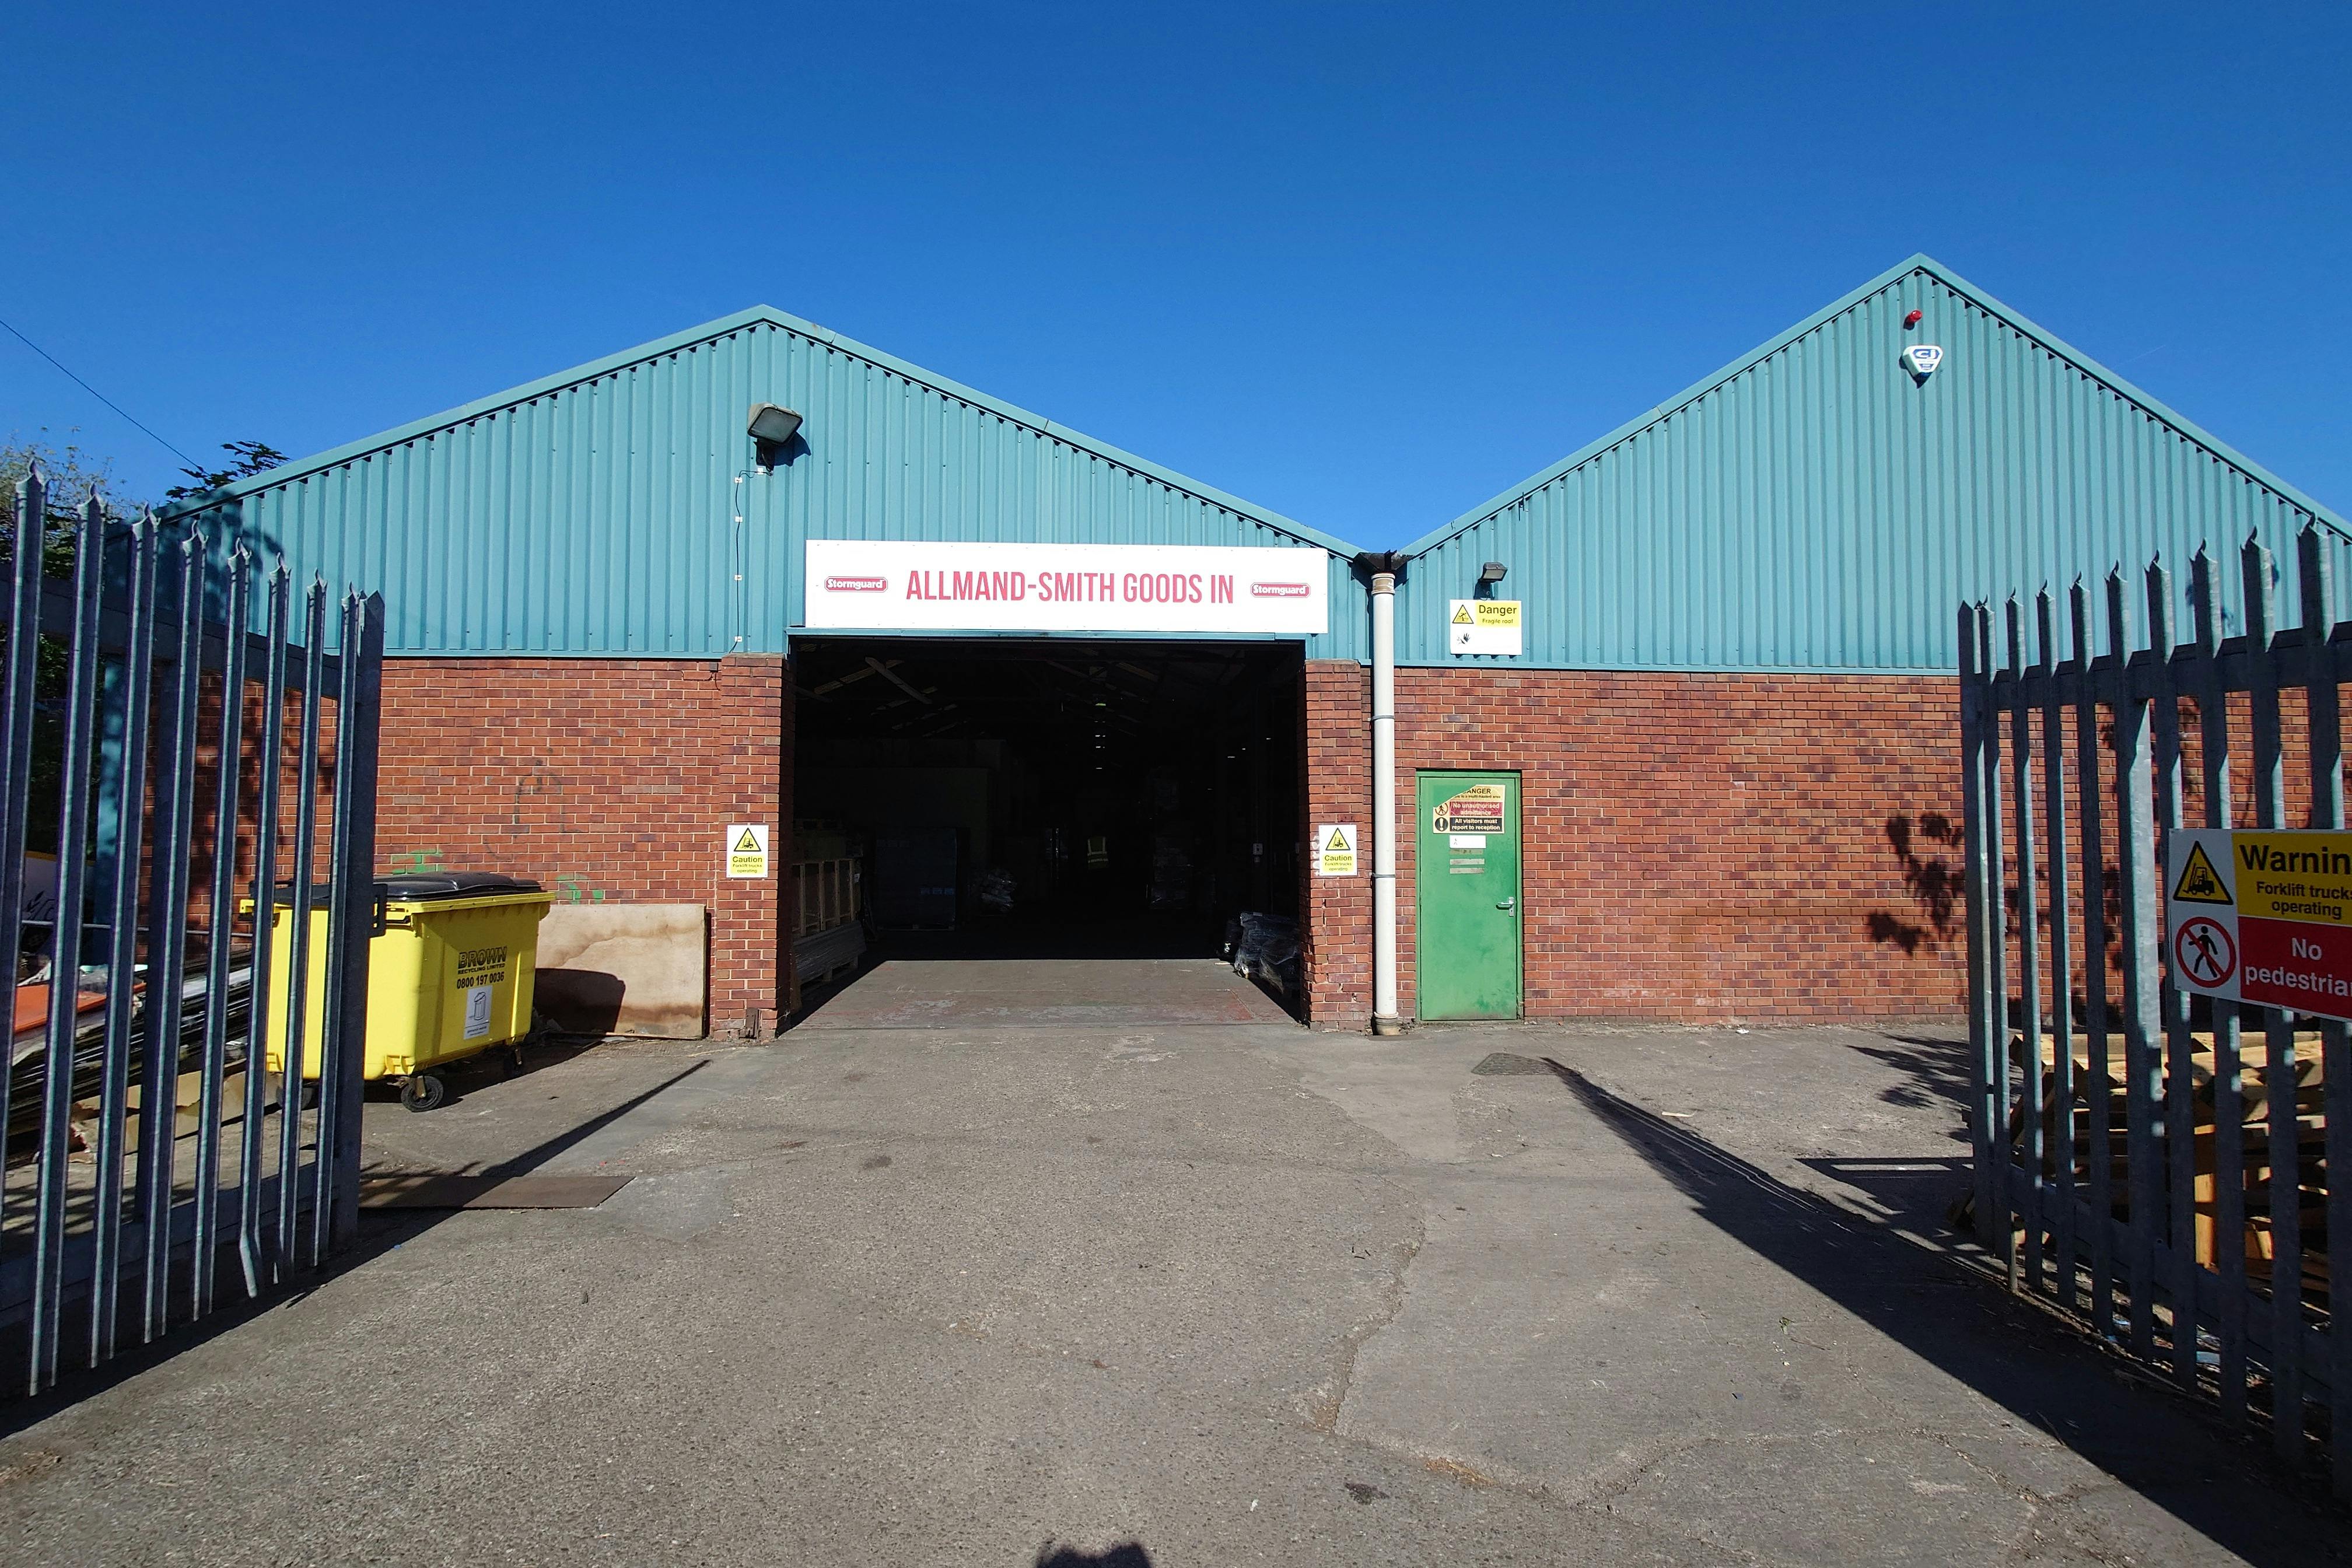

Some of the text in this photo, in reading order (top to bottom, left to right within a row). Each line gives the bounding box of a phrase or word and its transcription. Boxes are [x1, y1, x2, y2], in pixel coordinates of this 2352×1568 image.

[827, 578, 884, 590] Stormguard
[906, 570, 1233, 604] ALLMAND-SMITH GOODS IN
[1252, 584, 1307, 596] Stormguard
[1479, 604, 1517, 616] Danger
[2239, 844, 2352, 875] Warnin
[2256, 881, 2305, 897] Forklift
[2272, 901, 2342, 920] operating
[2291, 937, 2322, 960] No
[458, 946, 507, 969] BROWN
[457, 966, 486, 975] RECYCLING
[457, 977, 474, 989] 0800
[476, 974, 488, 986] 197
[2245, 965, 2352, 997] pedestria
